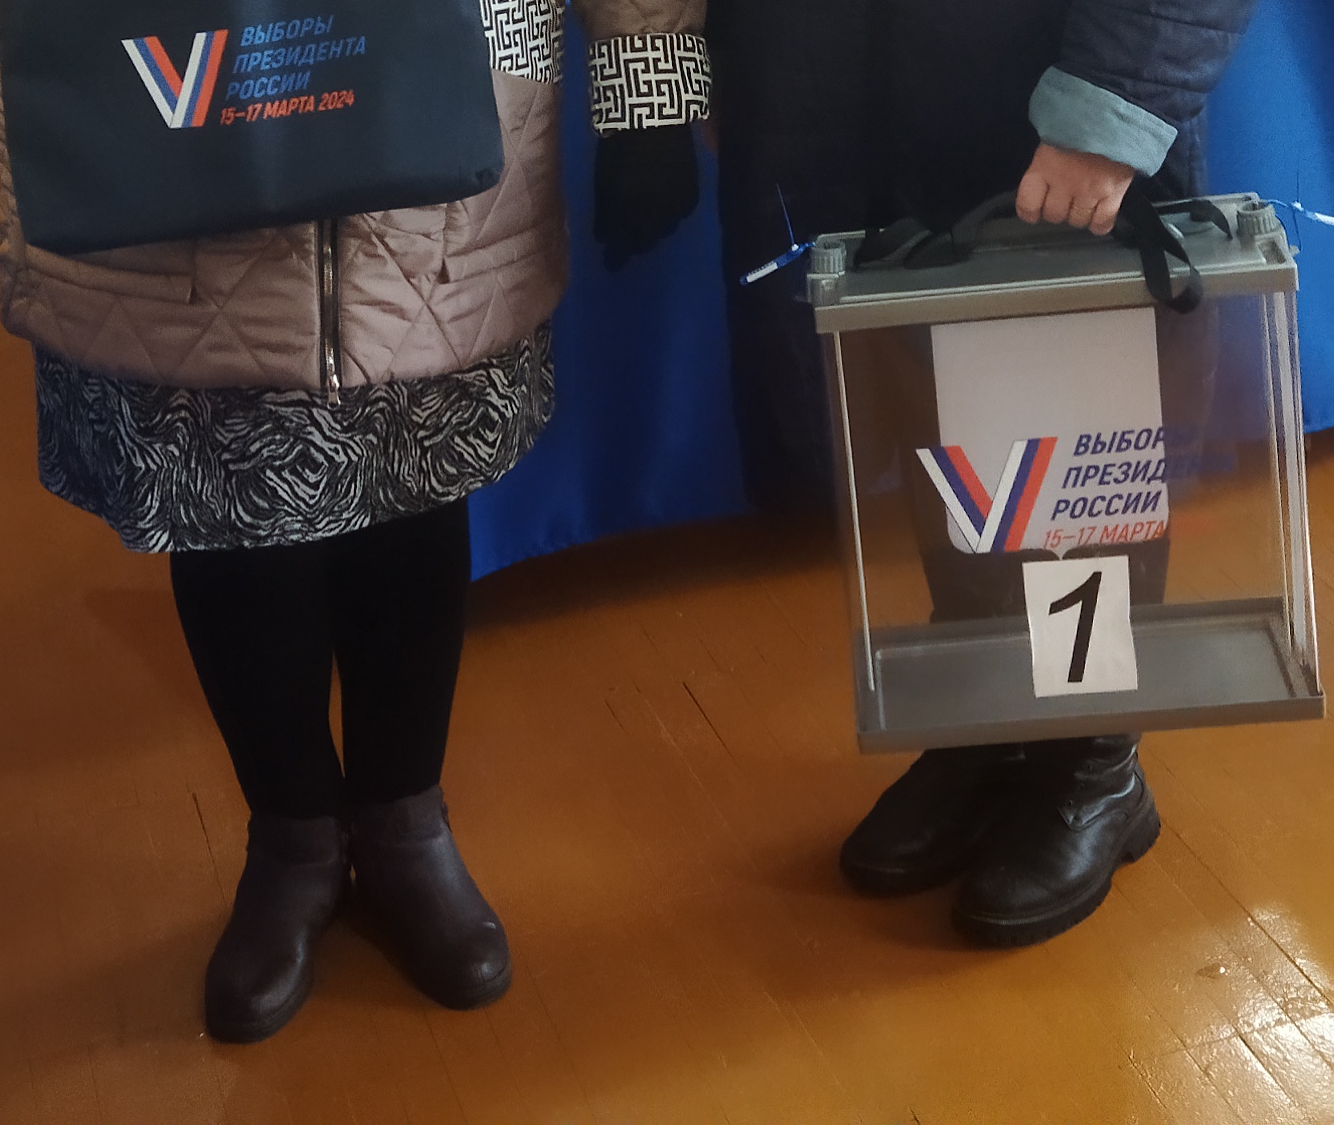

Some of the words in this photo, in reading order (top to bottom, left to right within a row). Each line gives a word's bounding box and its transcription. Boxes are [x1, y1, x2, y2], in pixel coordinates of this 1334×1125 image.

[240, 14, 334, 47] ВЫБОРЫ
[232, 35, 366, 74] ПРЕЗИДЕНТА
[225, 70, 311, 101] РОССИИ
[263, 94, 315, 120] МАРТА
[317, 89, 356, 112] 2024
[1073, 427, 1169, 457] ВЫБОР
[1062, 458, 1169, 489] ПРЕЗИД
[1051, 489, 1163, 522] РОССИИ
[1048, 571, 1103, 683] 1
